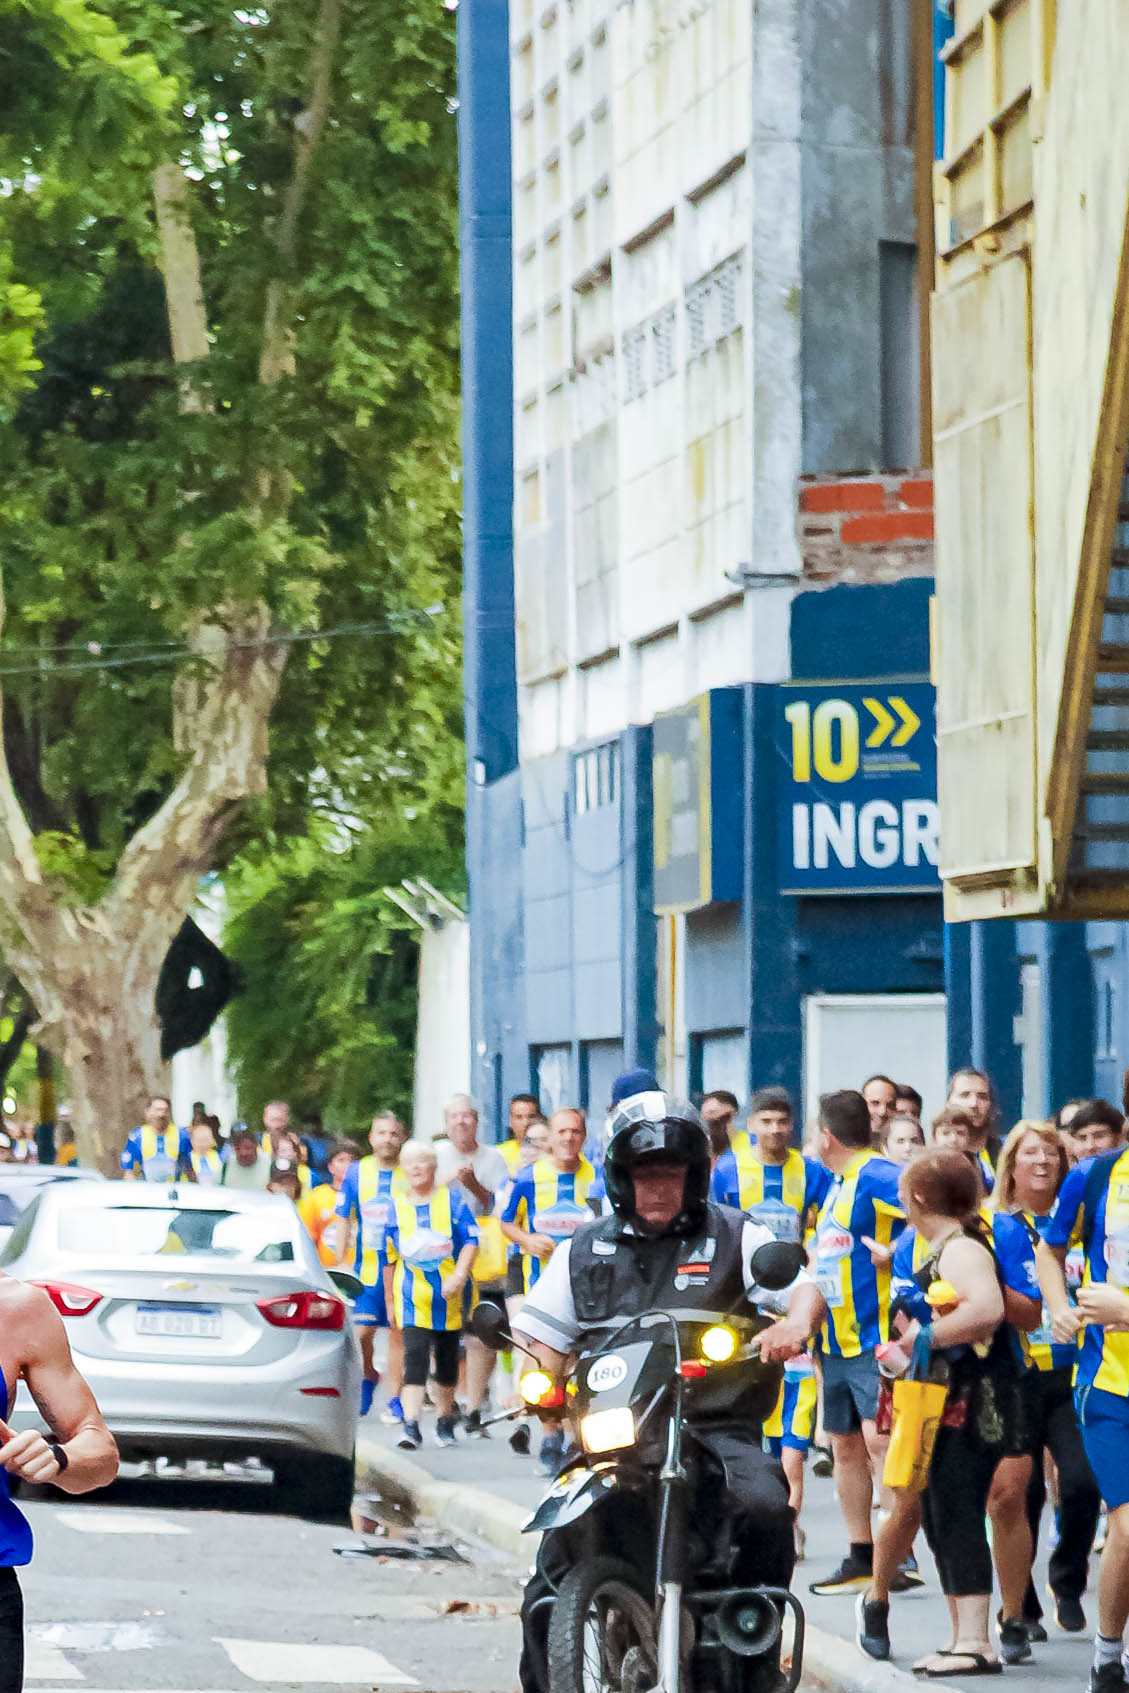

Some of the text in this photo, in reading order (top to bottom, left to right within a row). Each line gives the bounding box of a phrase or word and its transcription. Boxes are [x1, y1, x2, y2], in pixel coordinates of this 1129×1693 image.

[784, 699, 859, 783] 10
[792, 798, 940, 870] INGR
[593, 1366, 622, 1383] 180
